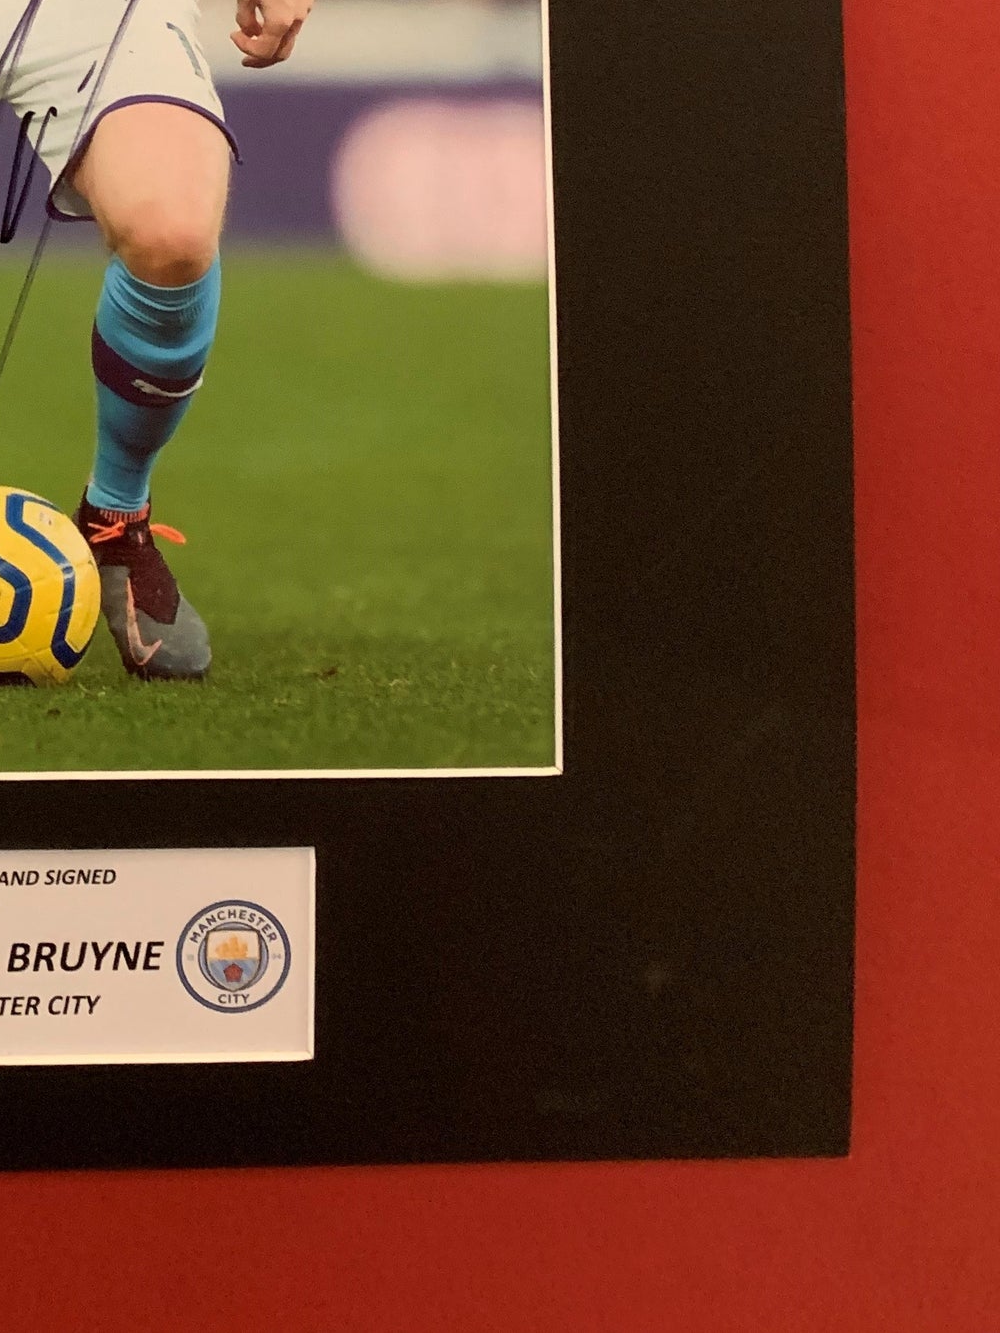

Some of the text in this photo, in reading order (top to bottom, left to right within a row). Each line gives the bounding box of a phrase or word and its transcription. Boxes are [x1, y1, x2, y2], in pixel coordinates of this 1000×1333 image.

[44, 869, 117, 885] SIGNED
[189, 909, 278, 944] MANCHESTER
[7, 941, 165, 972] BRUYNE
[48, 995, 101, 1015] CITY
[217, 993, 250, 1004] CITY
